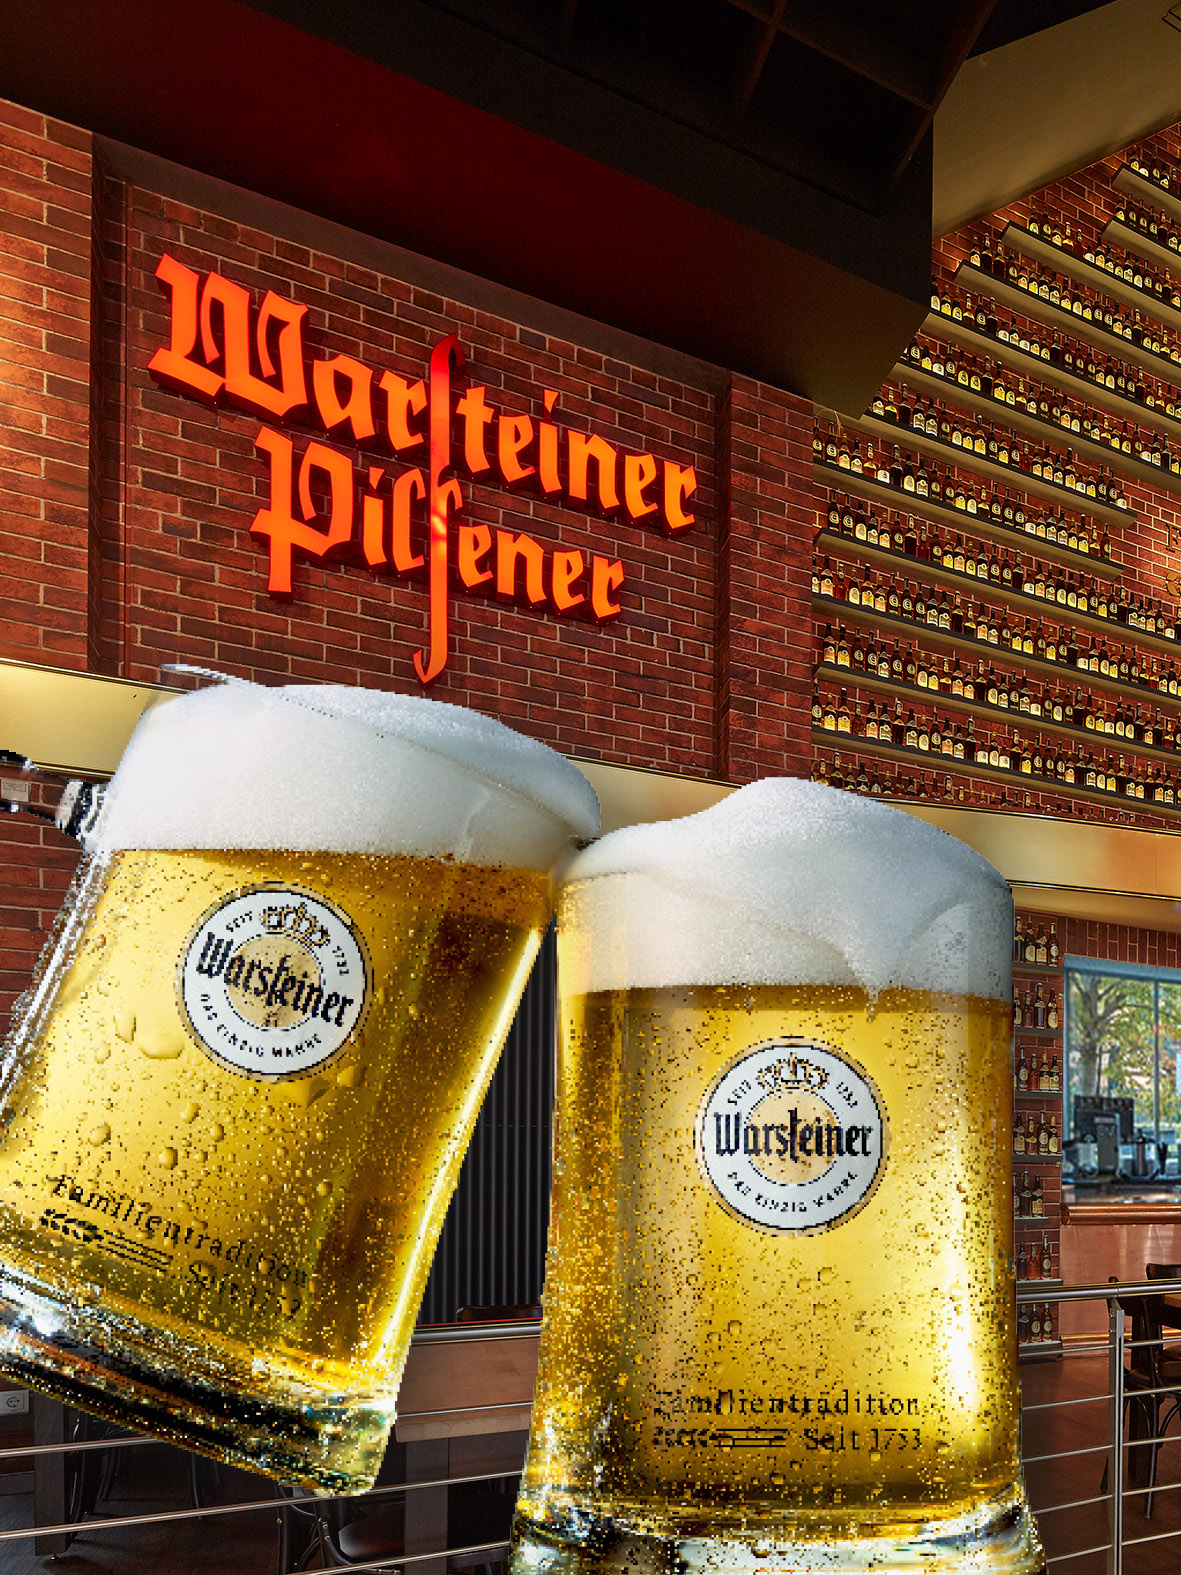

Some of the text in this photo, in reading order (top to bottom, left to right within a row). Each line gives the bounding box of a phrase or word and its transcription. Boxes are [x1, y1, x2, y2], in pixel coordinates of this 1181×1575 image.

[195, 931, 354, 1028] Warsteiner
[713, 1106, 874, 1164] Warsteiner
[803, 1427, 861, 1452] Seit
